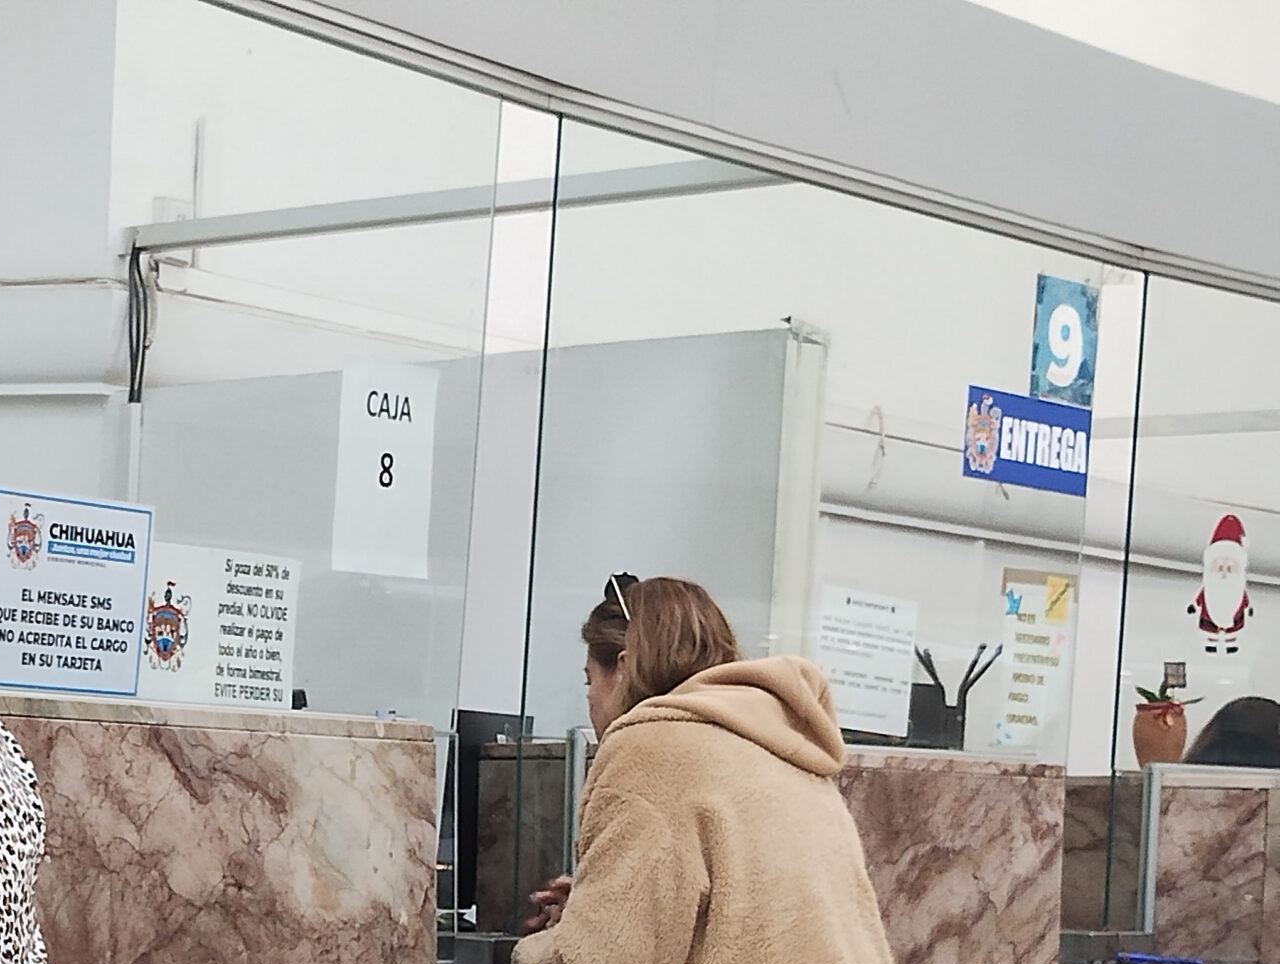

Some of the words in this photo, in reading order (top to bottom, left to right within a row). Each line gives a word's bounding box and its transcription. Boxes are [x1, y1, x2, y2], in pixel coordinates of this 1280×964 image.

[1046, 303, 1083, 387] 9
[366, 390, 412, 423] CAJA
[999, 416, 1087, 474] ENTREGA
[379, 453, 394, 488] 8
[49, 523, 135, 549] CHIHUAHUA
[225, 558, 233, 573] Si
[234, 563, 251, 578] goza
[253, 562, 263, 577] del
[264, 564, 279, 579] 50%
[281, 566, 290, 580] de
[22, 588, 34, 602] EL
[37, 591, 87, 609] MENSAJE
[90, 596, 112, 611] SMS
[226, 580, 263, 597] descuento
[265, 587, 273, 598] en
[274, 588, 284, 600] su
[21, 610, 59, 626] RECIBE
[62, 614, 77, 628] DE
[80, 615, 94, 630] SU
[97, 618, 134, 633] BANCO
[247, 605, 258, 618] NO
[260, 605, 288, 622] OLVIDE
[17, 631, 72, 649] ACREDITA
[75, 636, 87, 649] EL
[90, 638, 128, 653] CARGO
[220, 623, 246, 637] realizar
[248, 624, 254, 637] el
[255, 628, 273, 643] pago
[274, 627, 283, 641] de
[21, 653, 36, 666] EN
[39, 654, 54, 667] SU
[56, 655, 102, 671] TARJETA
[218, 643, 234, 657] todo
[236, 644, 243, 658] el
[244, 644, 258, 660] año
[259, 650, 264, 660] o
[216, 664, 224, 677] de
[226, 664, 247, 679] forma
[215, 682, 237, 698] EVITE
[239, 685, 271, 702] PERDER
[272, 688, 283, 702] SU
